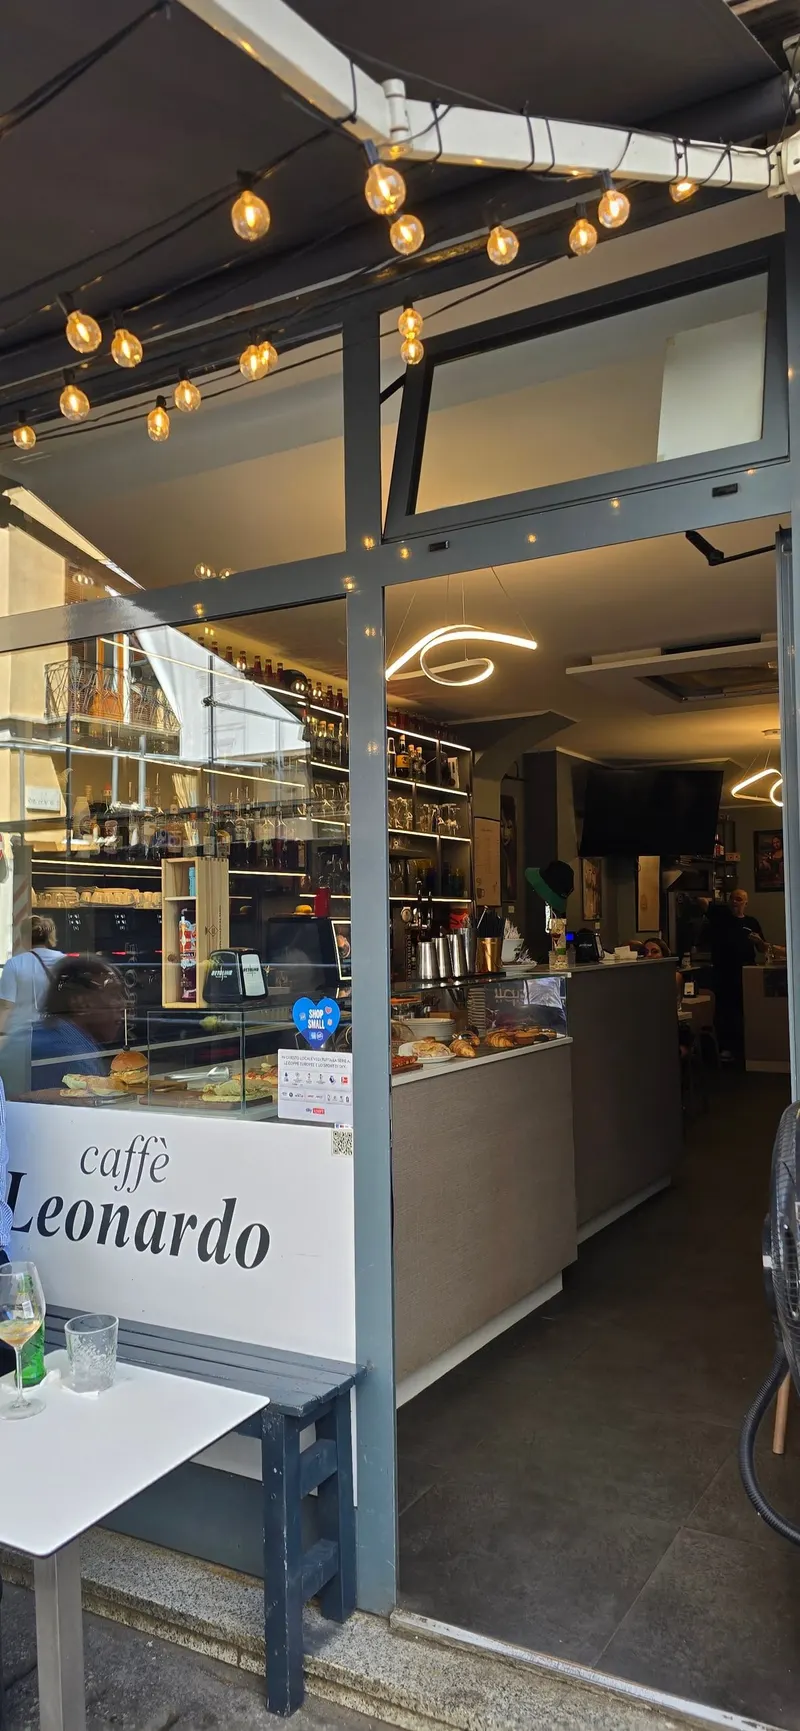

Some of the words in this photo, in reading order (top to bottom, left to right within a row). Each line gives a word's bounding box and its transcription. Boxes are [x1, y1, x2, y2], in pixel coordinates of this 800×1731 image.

[307, 1018, 325, 1030] SMALL
[308, 1009, 324, 1019] SHOP
[80, 1134, 170, 1193] caffè
[8, 1171, 270, 1269] Leonardo
